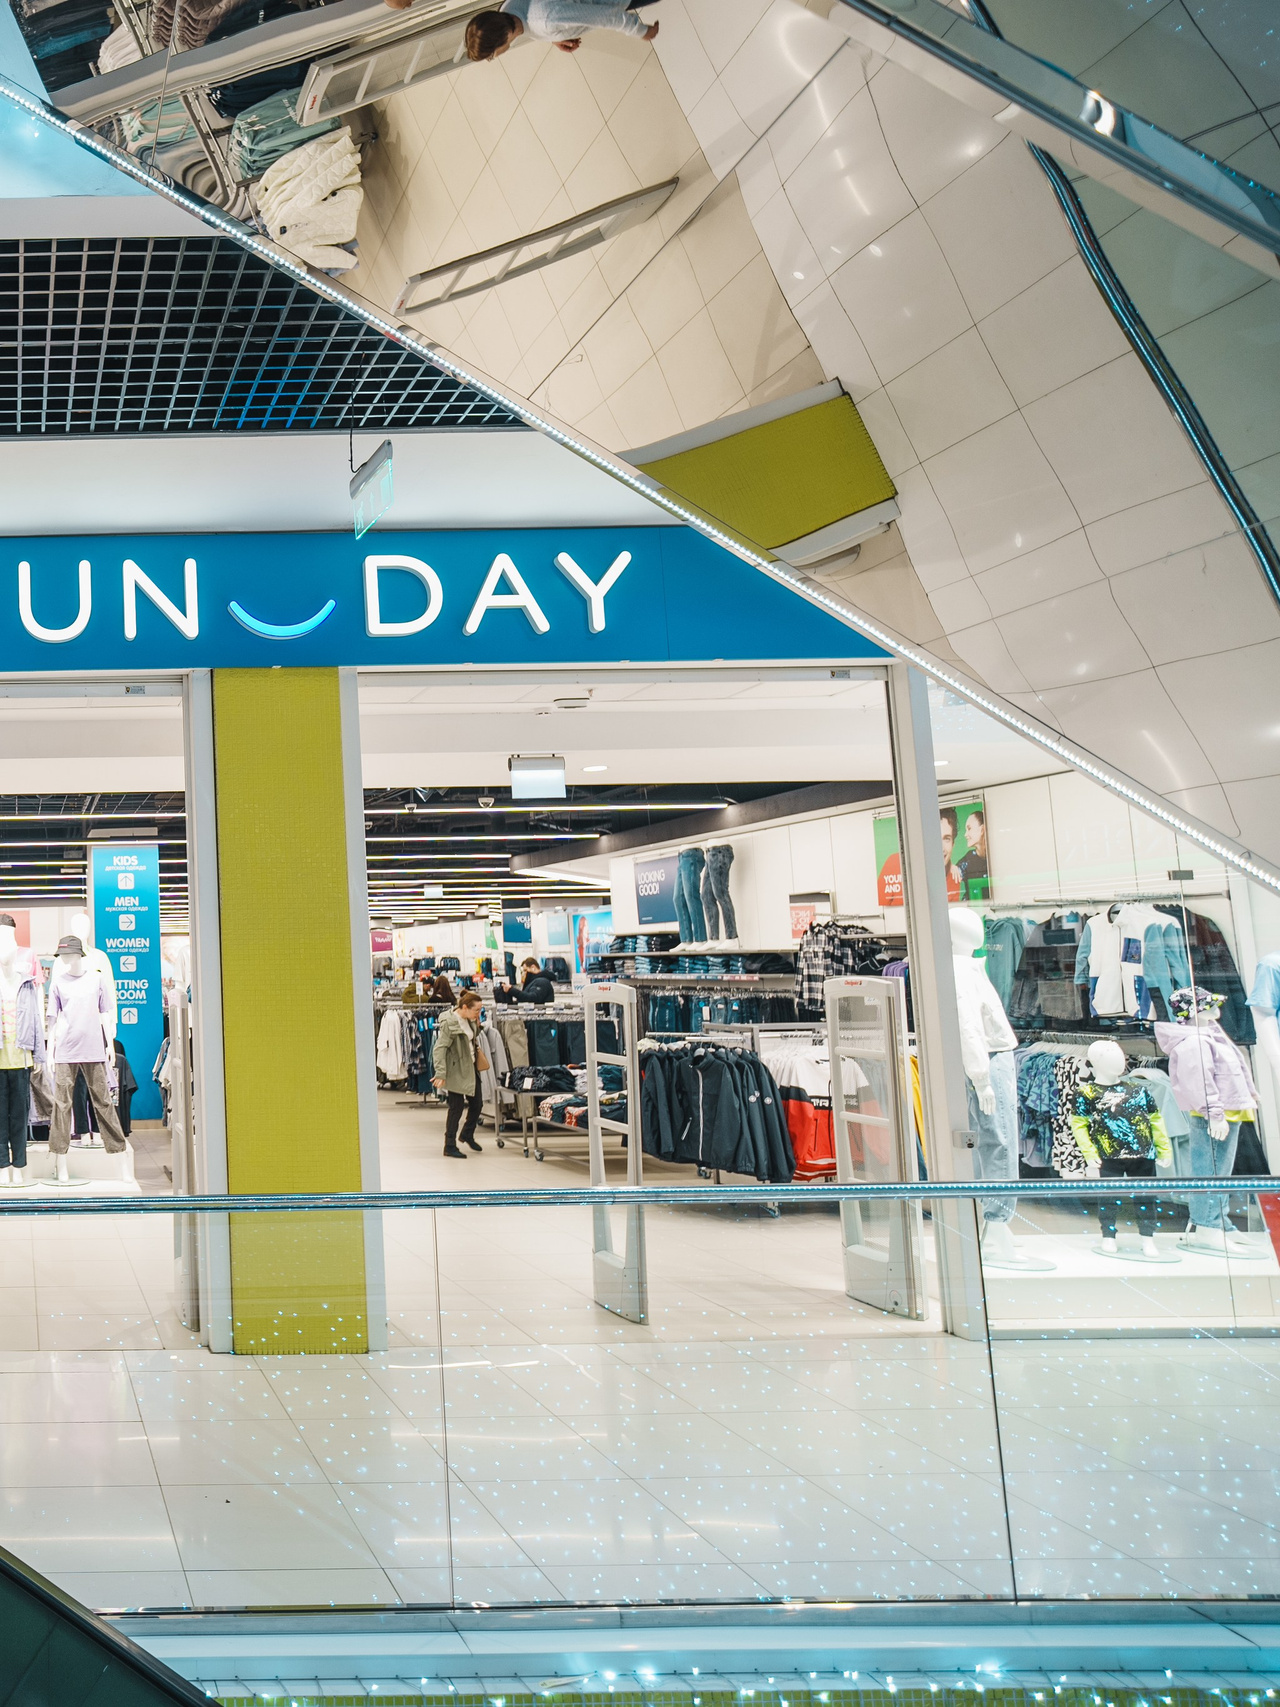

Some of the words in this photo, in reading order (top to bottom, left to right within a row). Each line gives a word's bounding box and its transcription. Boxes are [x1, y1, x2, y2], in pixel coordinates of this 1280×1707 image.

[363, 550, 632, 638] DAY
[113, 855, 139, 866] KIDS
[638, 869, 666, 884] LOOKING
[639, 882, 660, 896] GOOD!
[885, 884, 901, 893] AND
[114, 896, 140, 907] MEN
[105, 937, 150, 948] WOMEN
[114, 979, 149, 990] ITTING
